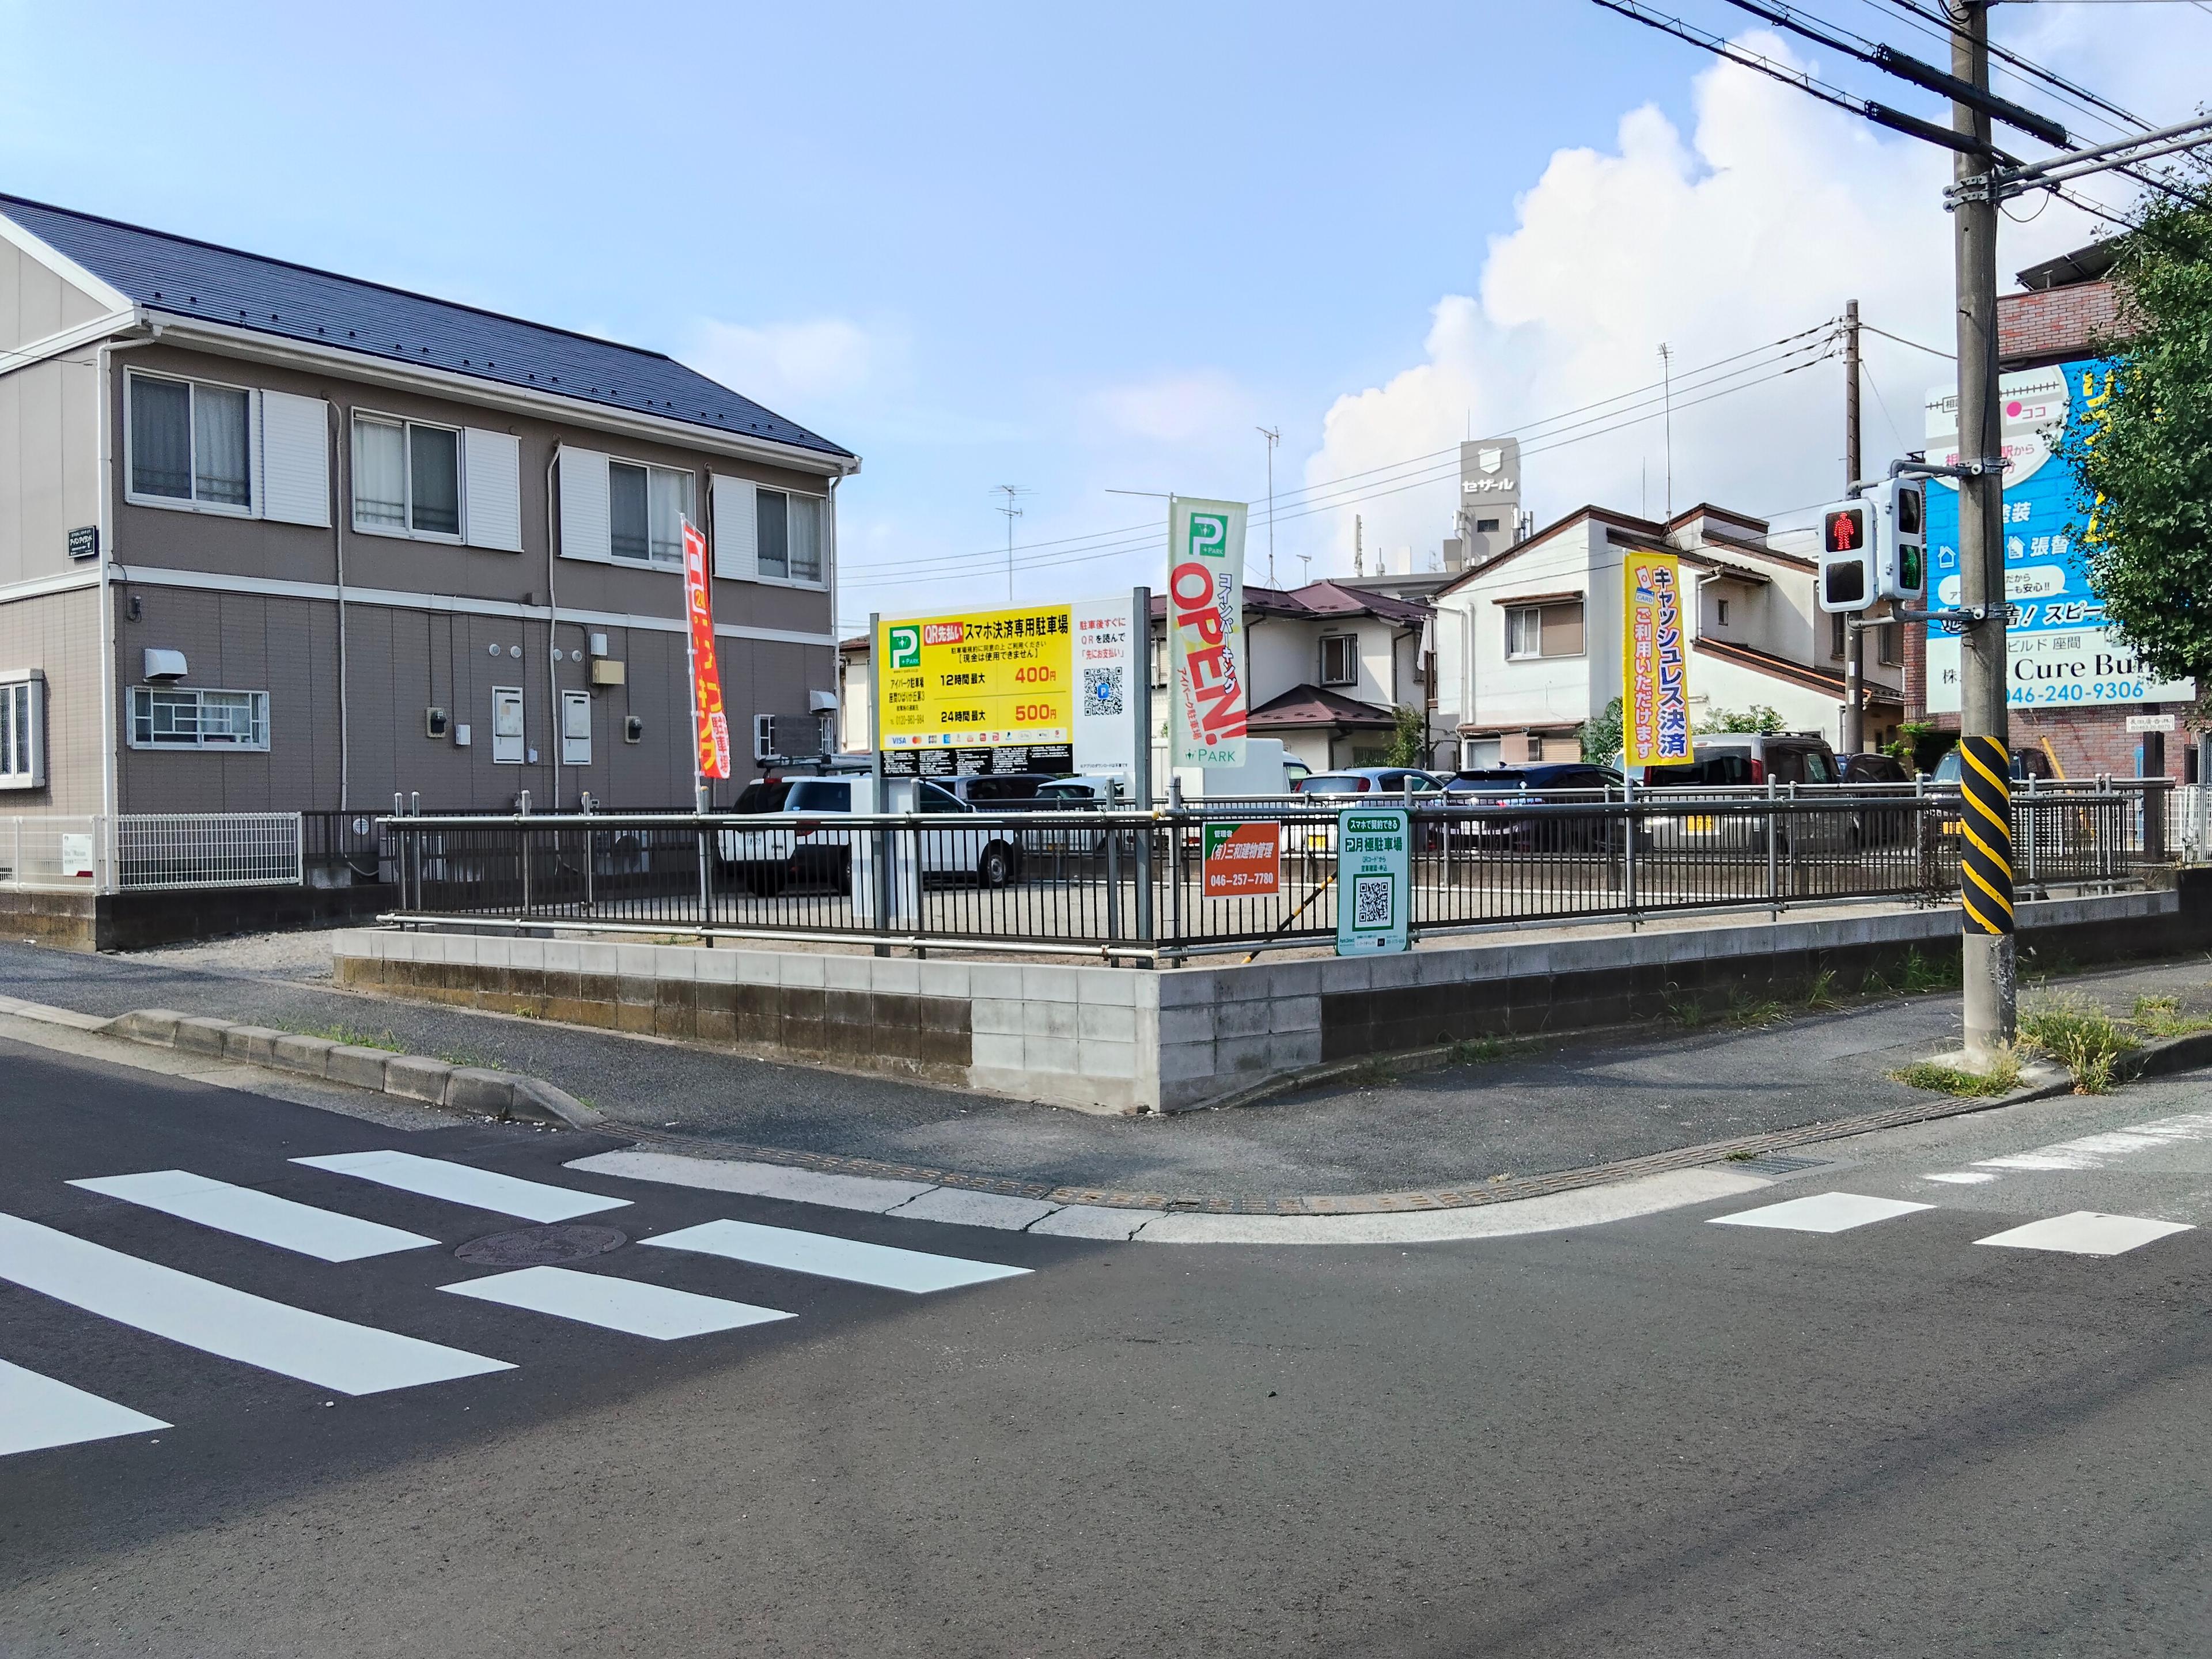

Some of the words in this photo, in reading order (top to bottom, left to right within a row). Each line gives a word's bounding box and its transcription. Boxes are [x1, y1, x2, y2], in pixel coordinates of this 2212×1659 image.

[2022, 407, 2046, 419] ココ
[1461, 478, 1514, 493] セザール
[2031, 535, 2070, 558] 張替
[1637, 594, 1653, 603] CARD
[925, 625, 963, 644] QR先払い
[965, 614, 1069, 641] スマホ決済専用駐車場
[1080, 618, 1126, 631] 駐車後すぐに
[1217, 573, 1236, 695] コインパーキング
[2052, 637, 2081, 650] 座間
[1170, 562, 1247, 746] OPEN!
[1654, 567, 1687, 757] キャッシュレス決済
[940, 673, 969, 686] 12時間
[971, 673, 986, 684] 最大
[1015, 666, 1056, 683] 400円
[2015, 658, 2086, 681] Cure
[891, 677, 925, 689] アイパーク駐車場
[1634, 608, 1653, 759] ご利用いただけます
[941, 711, 970, 723] 24時間
[971, 710, 986, 721] 最大
[1015, 704, 1056, 721] 500円
[1198, 749, 1236, 762] PARK
[1350, 820, 1397, 830] スマホで契約できる
[1214, 830, 1233, 838] 管理者
[1211, 842, 1274, 861] (有)三和建物管理
[1355, 836, 1403, 852] 月極駐車場
[1210, 872, 1274, 887] 046-257-7780
